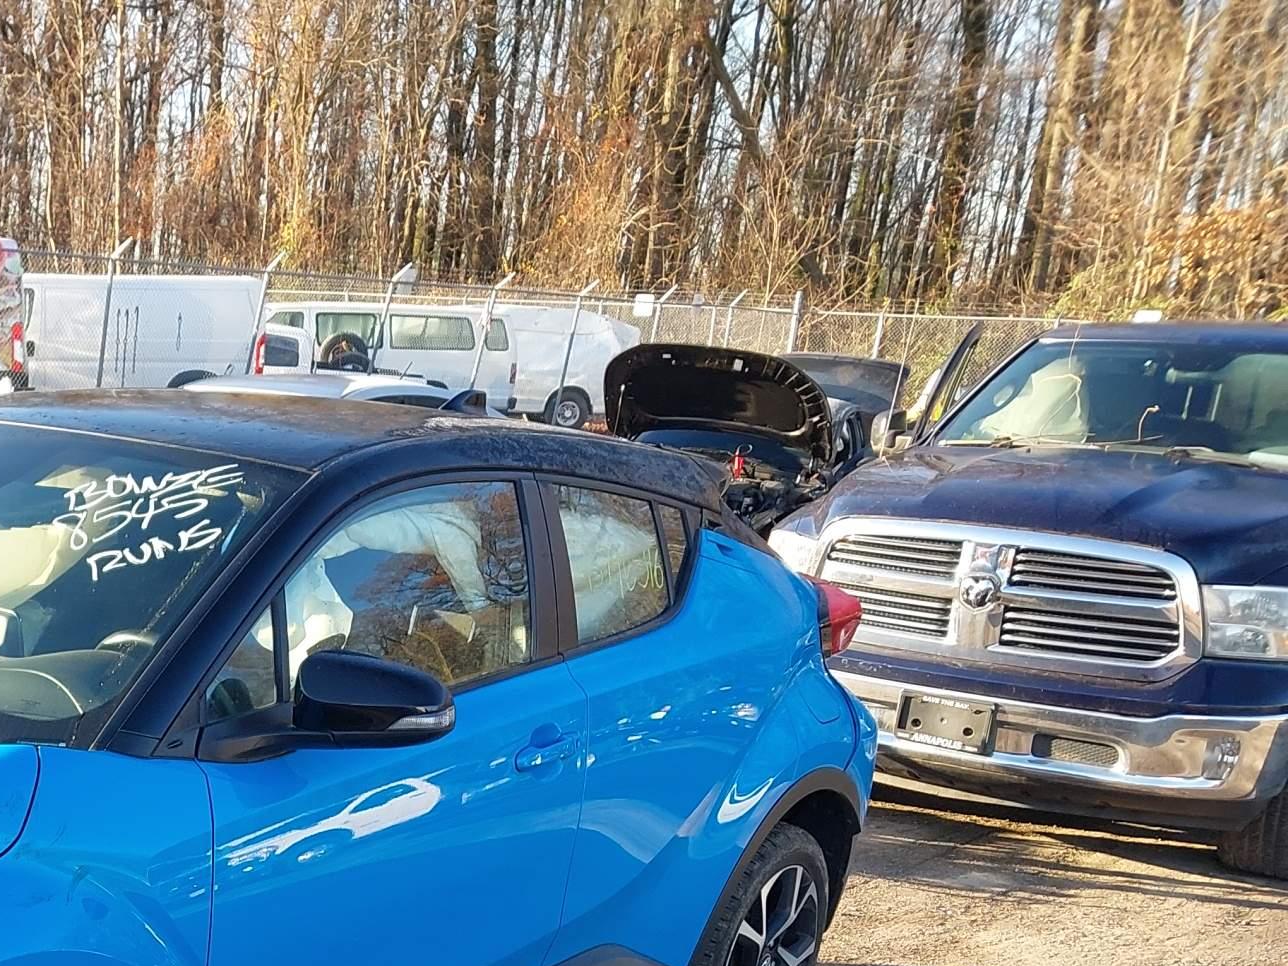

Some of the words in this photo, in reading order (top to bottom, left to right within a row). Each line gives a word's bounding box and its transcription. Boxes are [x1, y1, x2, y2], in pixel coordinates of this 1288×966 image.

[87, 519, 222, 581] RUNS
[922, 695, 940, 704] SAVE
[941, 698, 955, 707] THE
[911, 732, 963, 749] ANNAPOLIS
